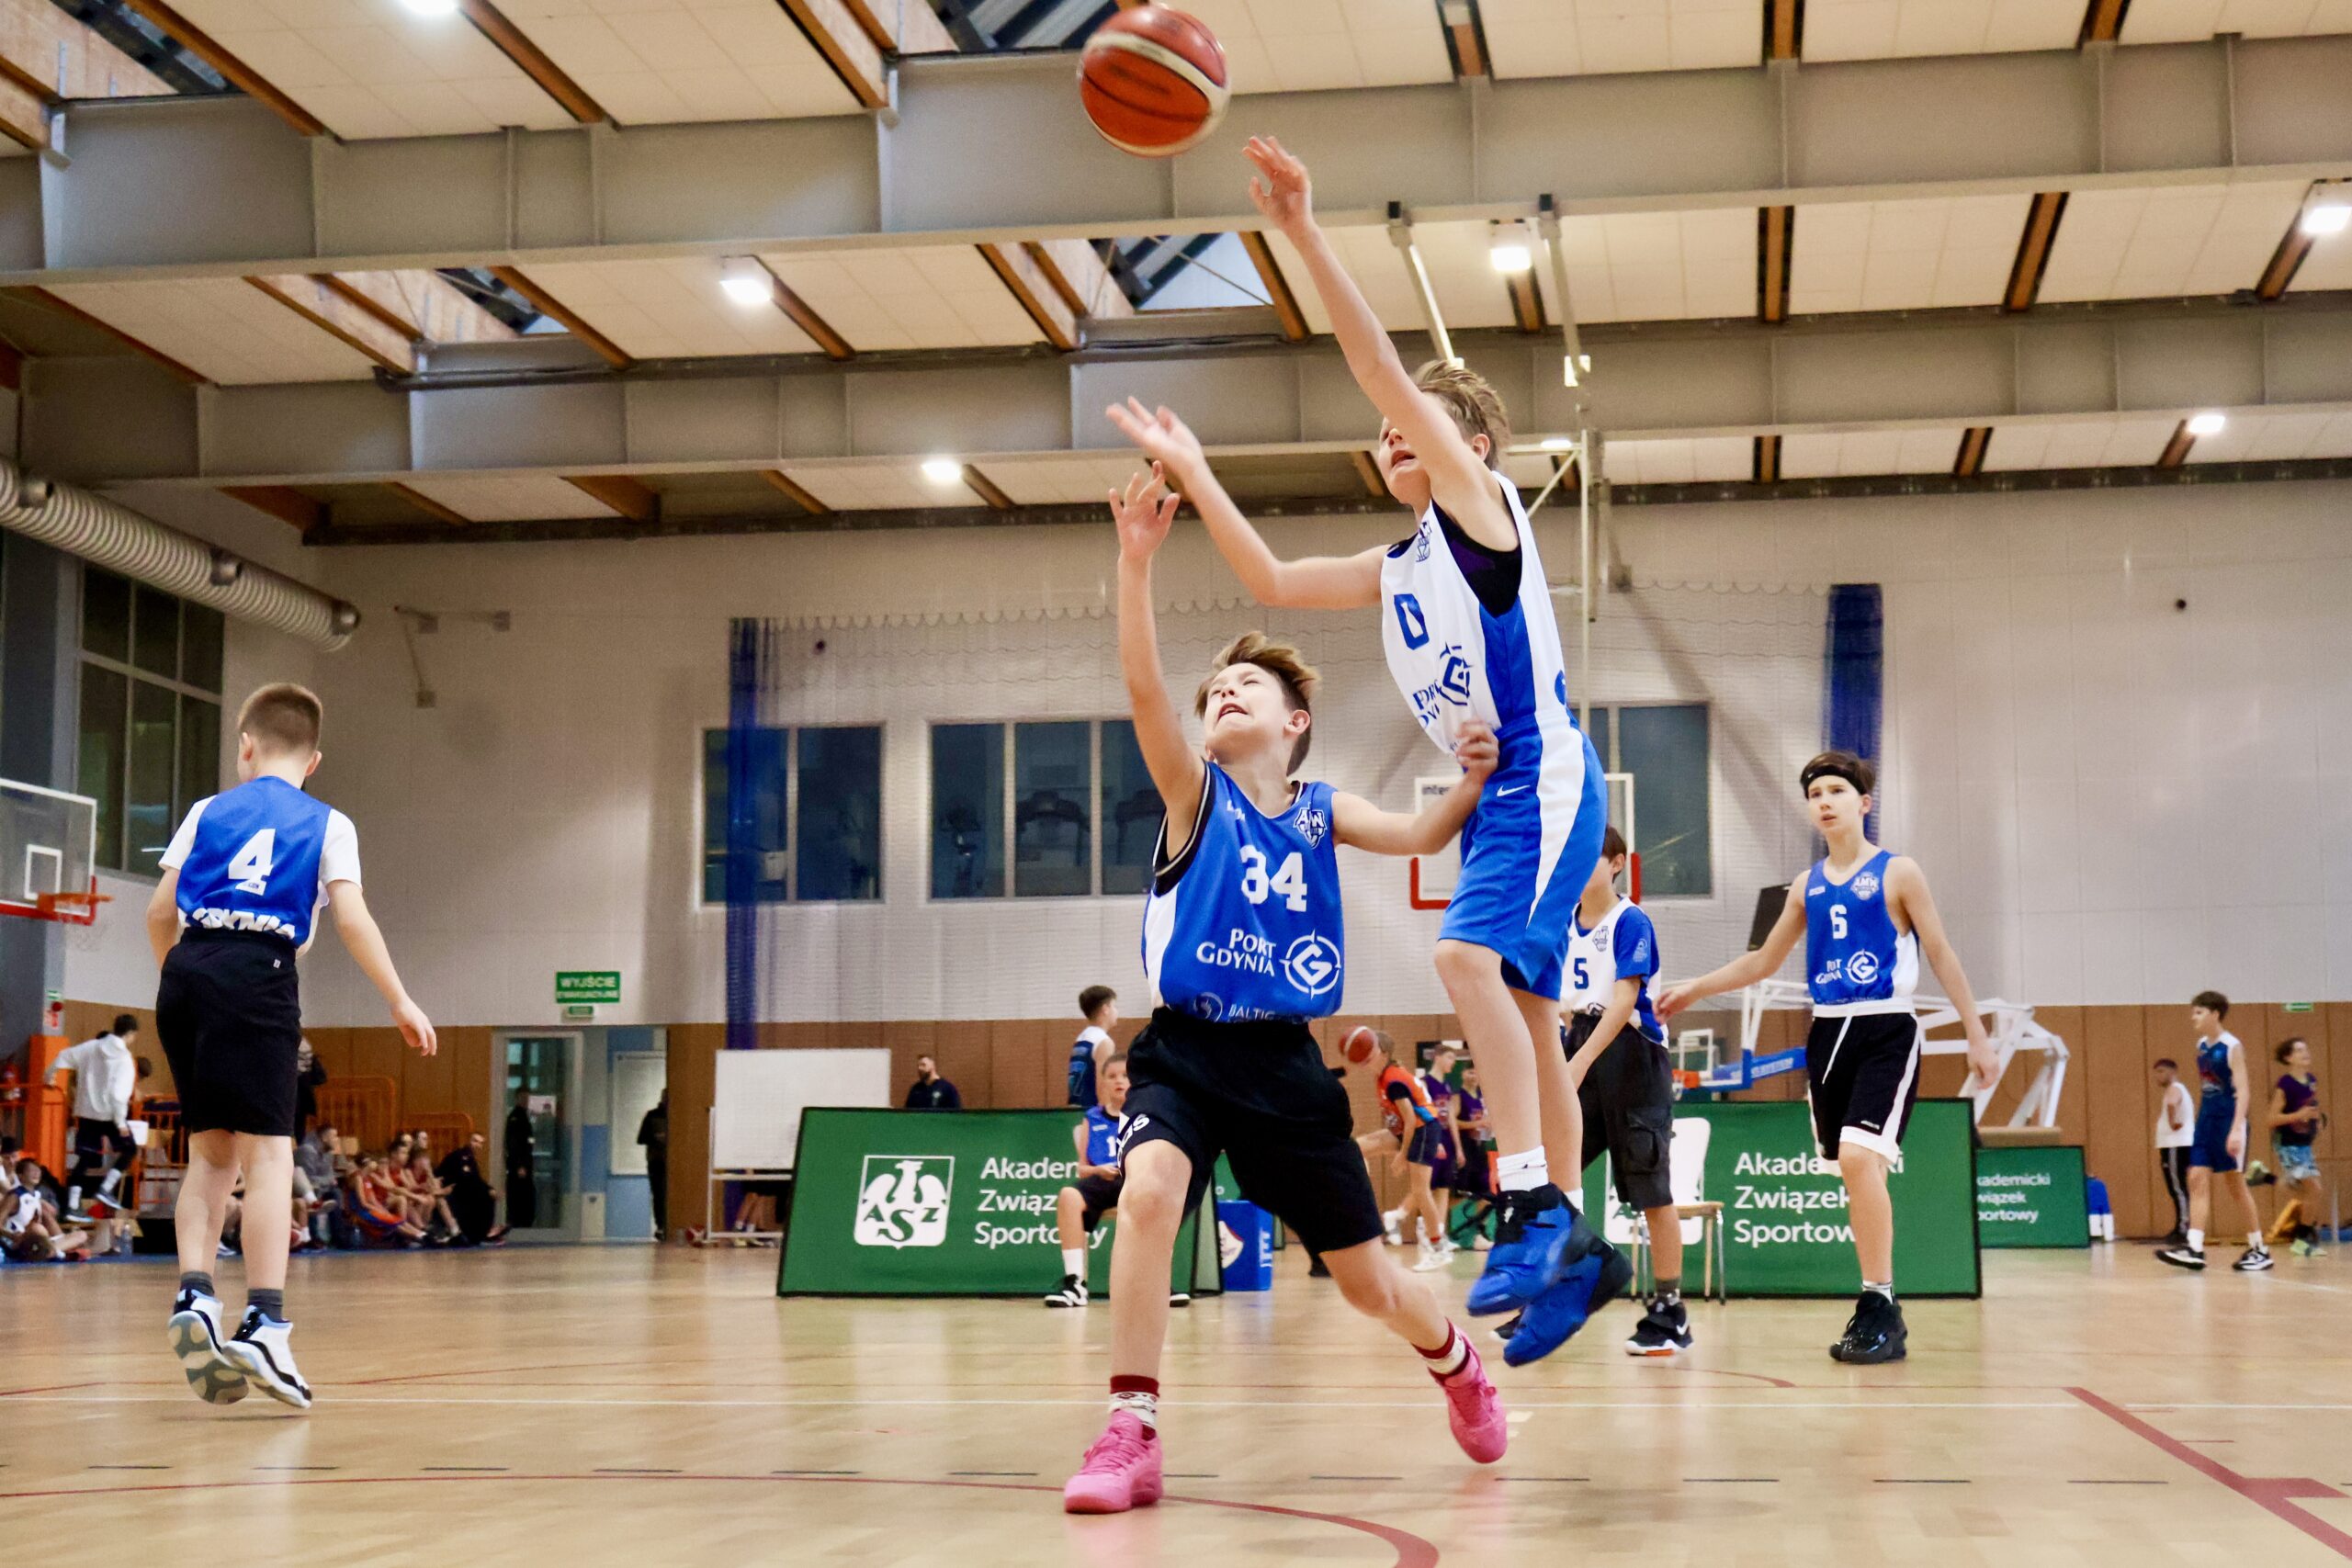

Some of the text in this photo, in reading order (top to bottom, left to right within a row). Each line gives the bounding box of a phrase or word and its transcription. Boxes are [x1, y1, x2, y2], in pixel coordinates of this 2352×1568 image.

[228, 829, 276, 896] 4
[1240, 845, 1307, 912] 34
[1829, 904, 1848, 939] 6
[1196, 942, 1275, 977] GDYNIA
[1228, 928, 1276, 958] PORT
[1574, 957, 1589, 990] 5
[978, 1189, 1058, 1216] Związ
[974, 1221, 1108, 1250] Sportoy
[1734, 1219, 1856, 1248] Sportow
